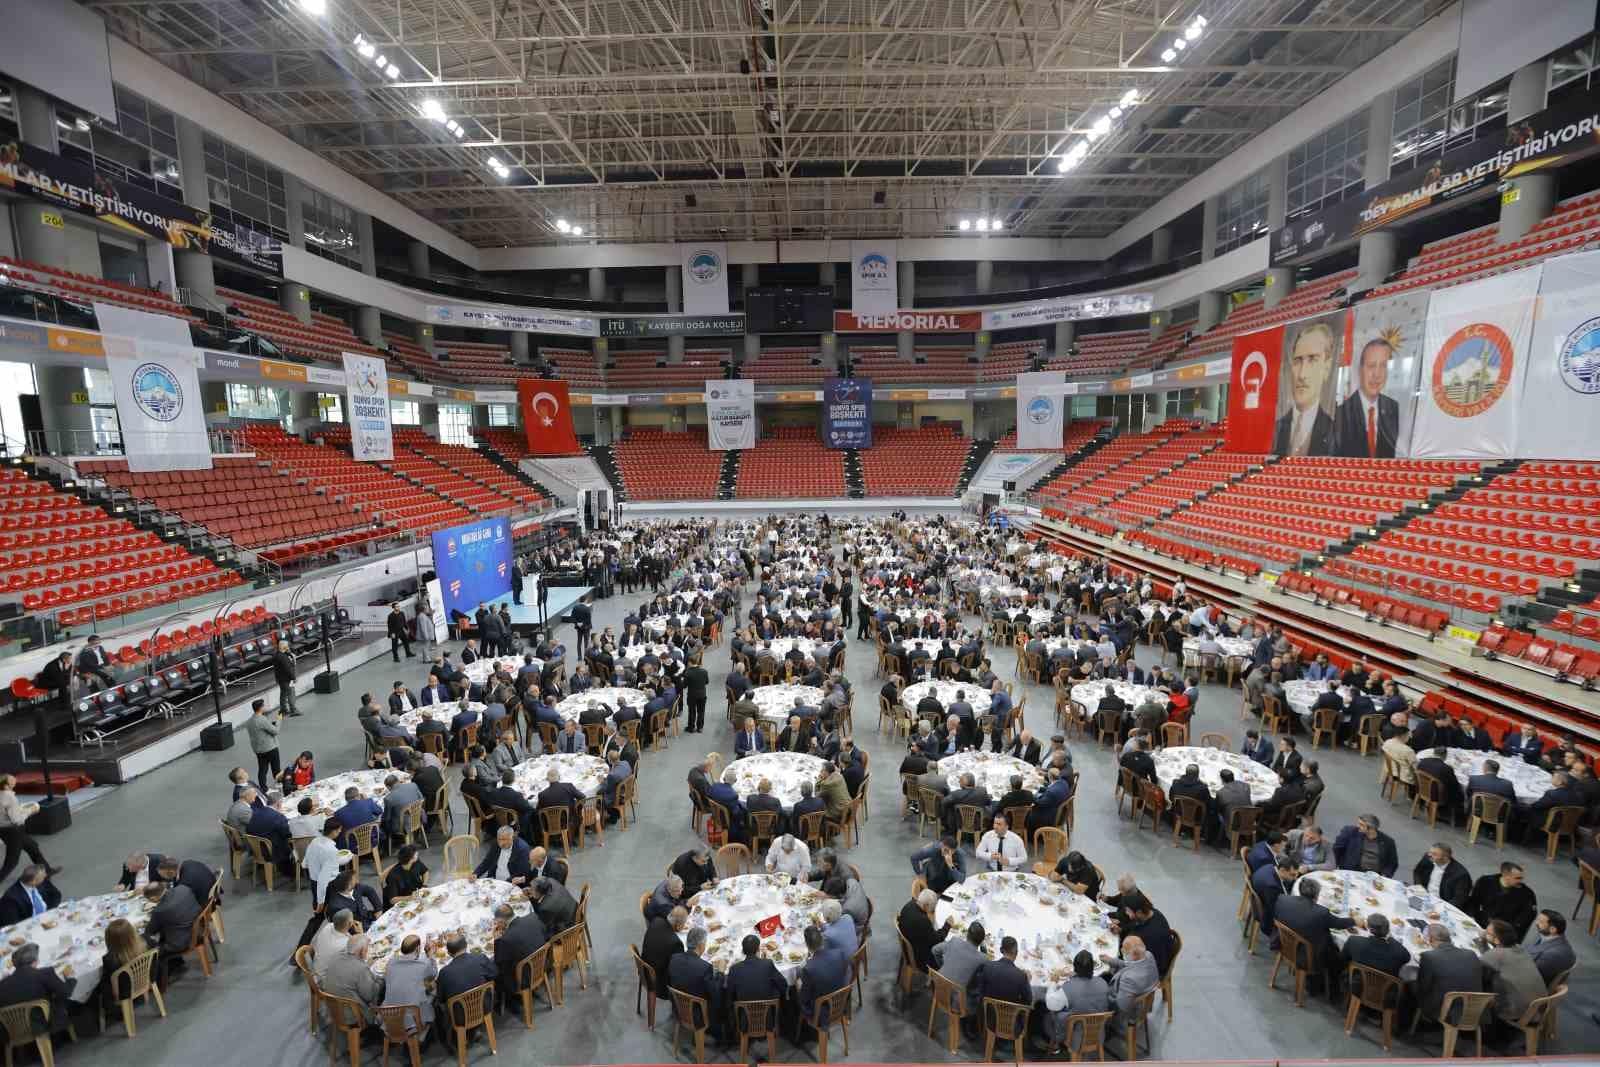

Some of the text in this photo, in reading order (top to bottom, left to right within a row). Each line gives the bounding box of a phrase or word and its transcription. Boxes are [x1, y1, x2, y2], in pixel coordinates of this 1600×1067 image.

[608, 319, 625, 331] İTÜ
[713, 319, 744, 329] KOLEJİ
[857, 313, 961, 330] MEMORIAL
